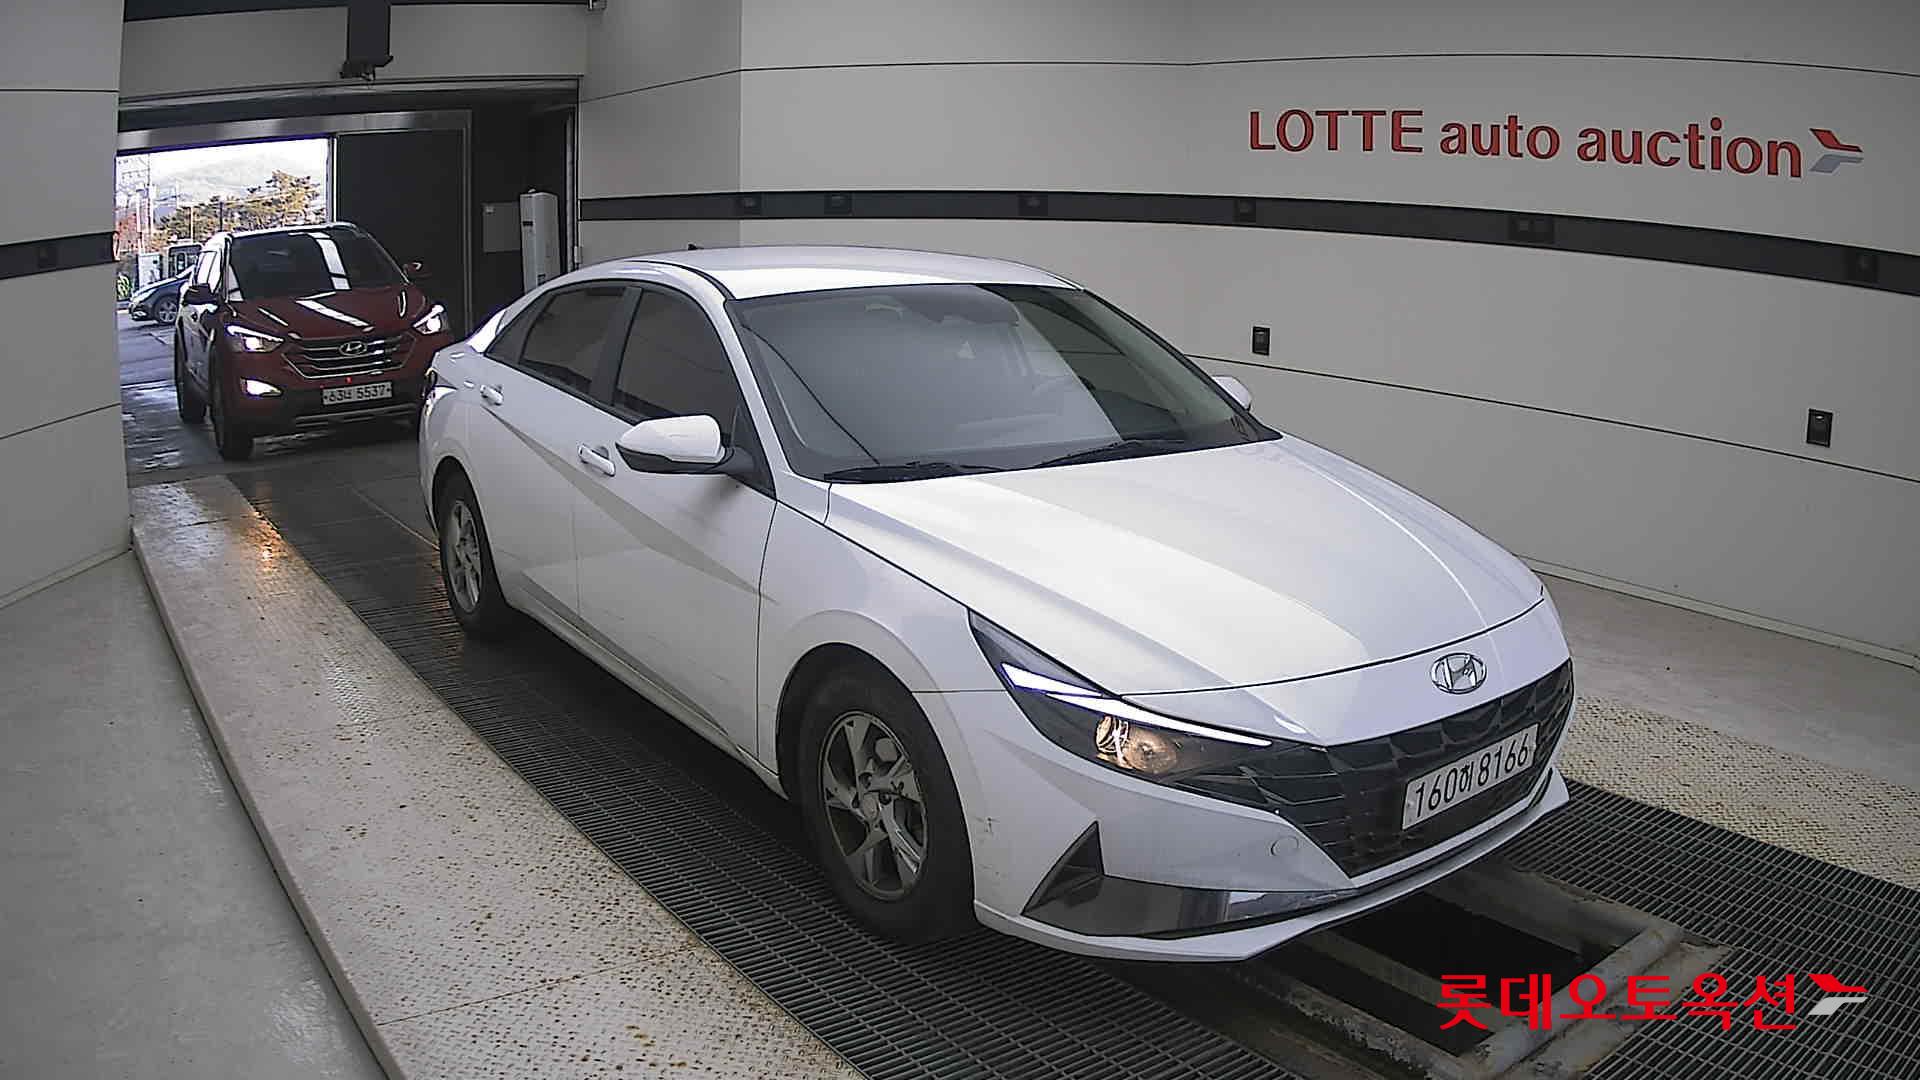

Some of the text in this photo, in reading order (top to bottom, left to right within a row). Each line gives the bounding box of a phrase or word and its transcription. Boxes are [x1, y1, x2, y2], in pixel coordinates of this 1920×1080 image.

[1250, 110, 1802, 178] LOTTE auto auction
